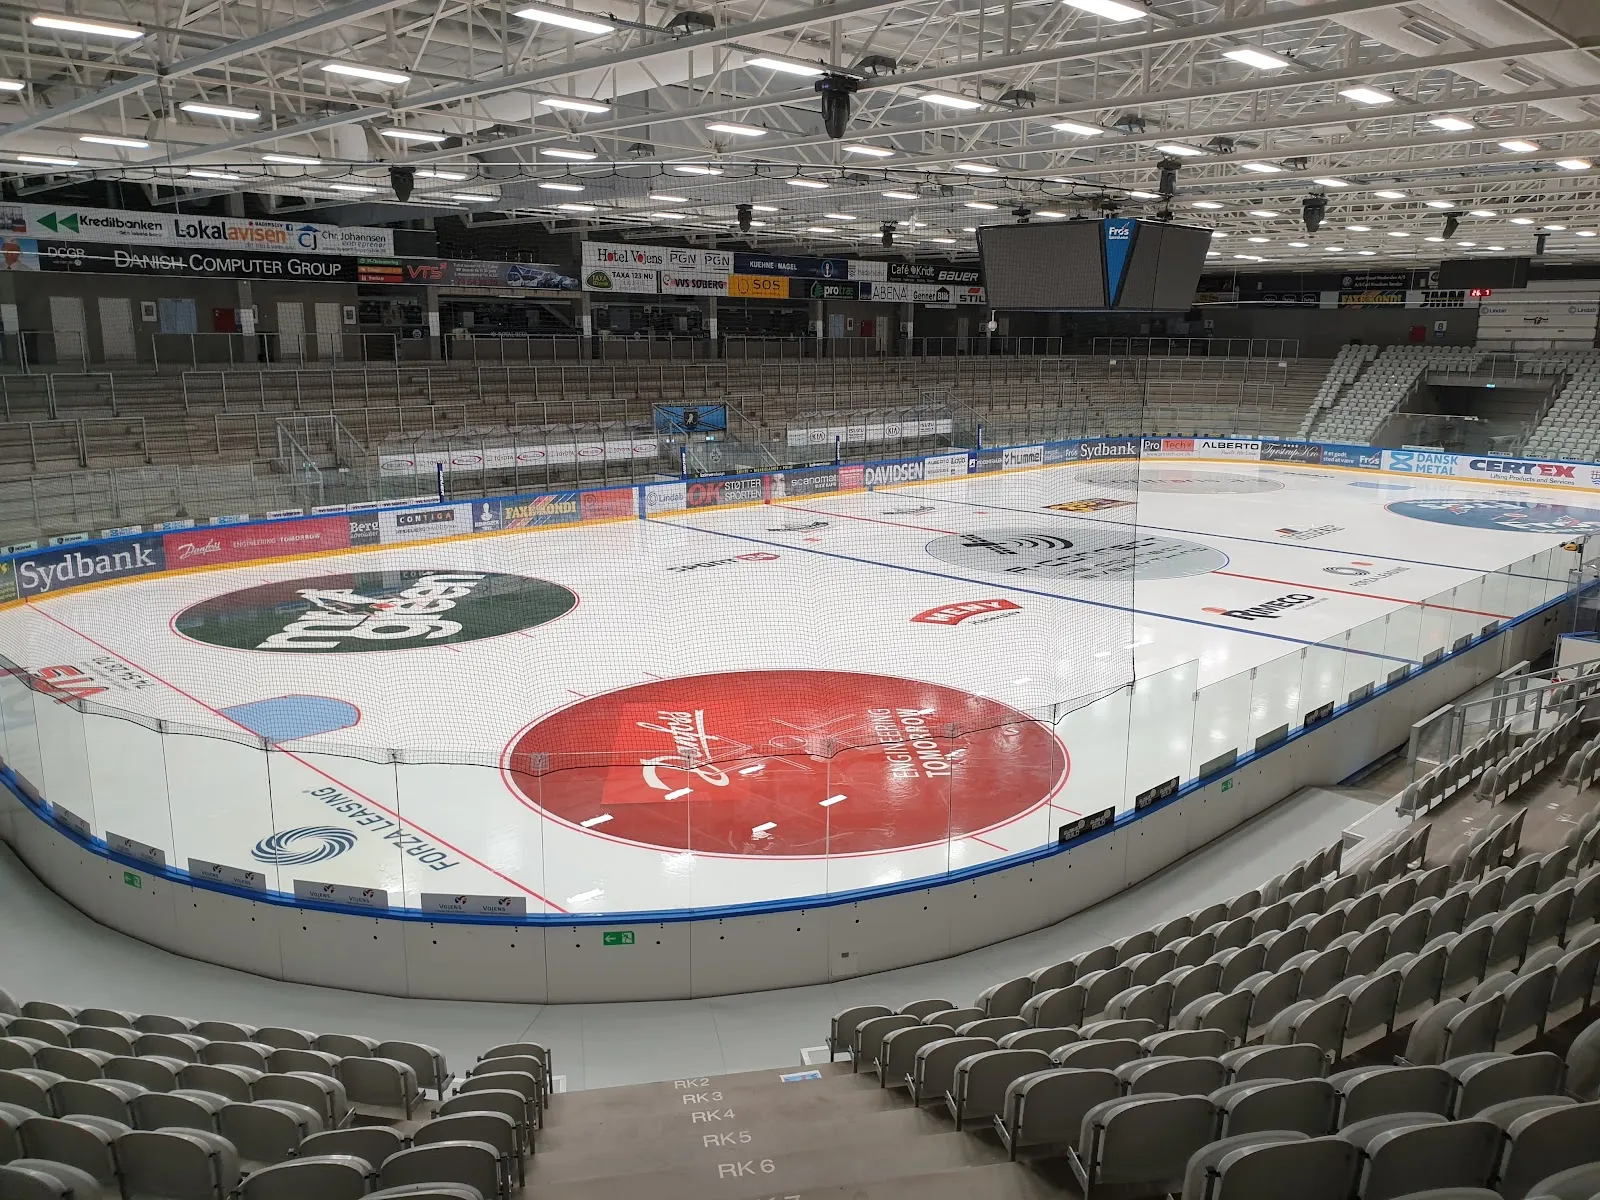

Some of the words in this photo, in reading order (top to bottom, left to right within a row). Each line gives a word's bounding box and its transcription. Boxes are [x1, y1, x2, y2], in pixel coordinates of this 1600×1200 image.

[80, 215, 162, 231] Kreditbanken
[174, 219, 287, 245] Lokalavisen
[322, 230, 339, 240] Chr.
[340, 231, 386, 242] Johannsen
[114, 250, 184, 270] DANISH
[189, 253, 282, 274] COMPUTER
[287, 259, 342, 276] GROUP
[597, 248, 629, 263] Hotel
[631, 250, 663, 265] Vojens
[670, 253, 696, 264] PGN
[705, 255, 730, 265] PGN
[749, 260, 774, 269] KUEHNE
[777, 262, 798, 270] NAGEL
[891, 264, 909, 275] Café
[612, 271, 630, 279] TAXA
[938, 270, 979, 282] BAUER
[675, 279, 690, 288] VVS
[753, 279, 780, 290] SOS
[873, 286, 907, 300] ABENA
[913, 291, 936, 301] Genner
[1577, 306, 1597, 314] Lindab
[1438, 322, 1444, 331] 8
[1080, 442, 1137, 460] Sydbank
[1144, 441, 1160, 450] Pro
[1165, 440, 1187, 449] Tech
[1202, 441, 1259, 450] ALBERTO
[1010, 450, 1042, 466] hummel
[1417, 453, 1458, 466] DANSK
[865, 461, 923, 486] DAVIDSEN
[1416, 463, 1456, 476] METAL
[1469, 459, 1576, 478] CERTEX
[725, 478, 762, 490] STØTTER
[1510, 474, 1536, 482] Products
[1549, 477, 1575, 486] Services
[658, 492, 684, 502] Lindab
[688, 481, 725, 506] OK
[725, 489, 762, 502] SPORTEN
[505, 504, 537, 520] FAXE
[538, 501, 577, 515] KONDI
[399, 511, 452, 524] CONTIGA
[349, 521, 379, 534] Berg
[233, 537, 276, 549] ENGINEERING
[280, 533, 321, 543] TOMORROW
[178, 539, 221, 560] Danfoss
[20, 543, 157, 593] Sydbank
[867, 708, 920, 778] ENGINEERING
[896, 707, 951, 779] TOMORROW
[310, 786, 395, 832] LEASING
[383, 828, 460, 871] FORZA
[309, 890, 331, 899] VOJENS
[438, 902, 462, 911] VOJENS
[482, 904, 506, 913] VOJENS
[674, 1078, 699, 1090] RK
[700, 1077, 711, 1087] 2
[682, 1092, 709, 1105] RK
[712, 1091, 724, 1101] 3
[691, 1110, 722, 1124] RK
[723, 1108, 736, 1120] 4
[703, 1132, 737, 1148] RK
[739, 1130, 752, 1144] 5
[718, 1160, 756, 1179] RK
[760, 1158, 776, 1174] 6
